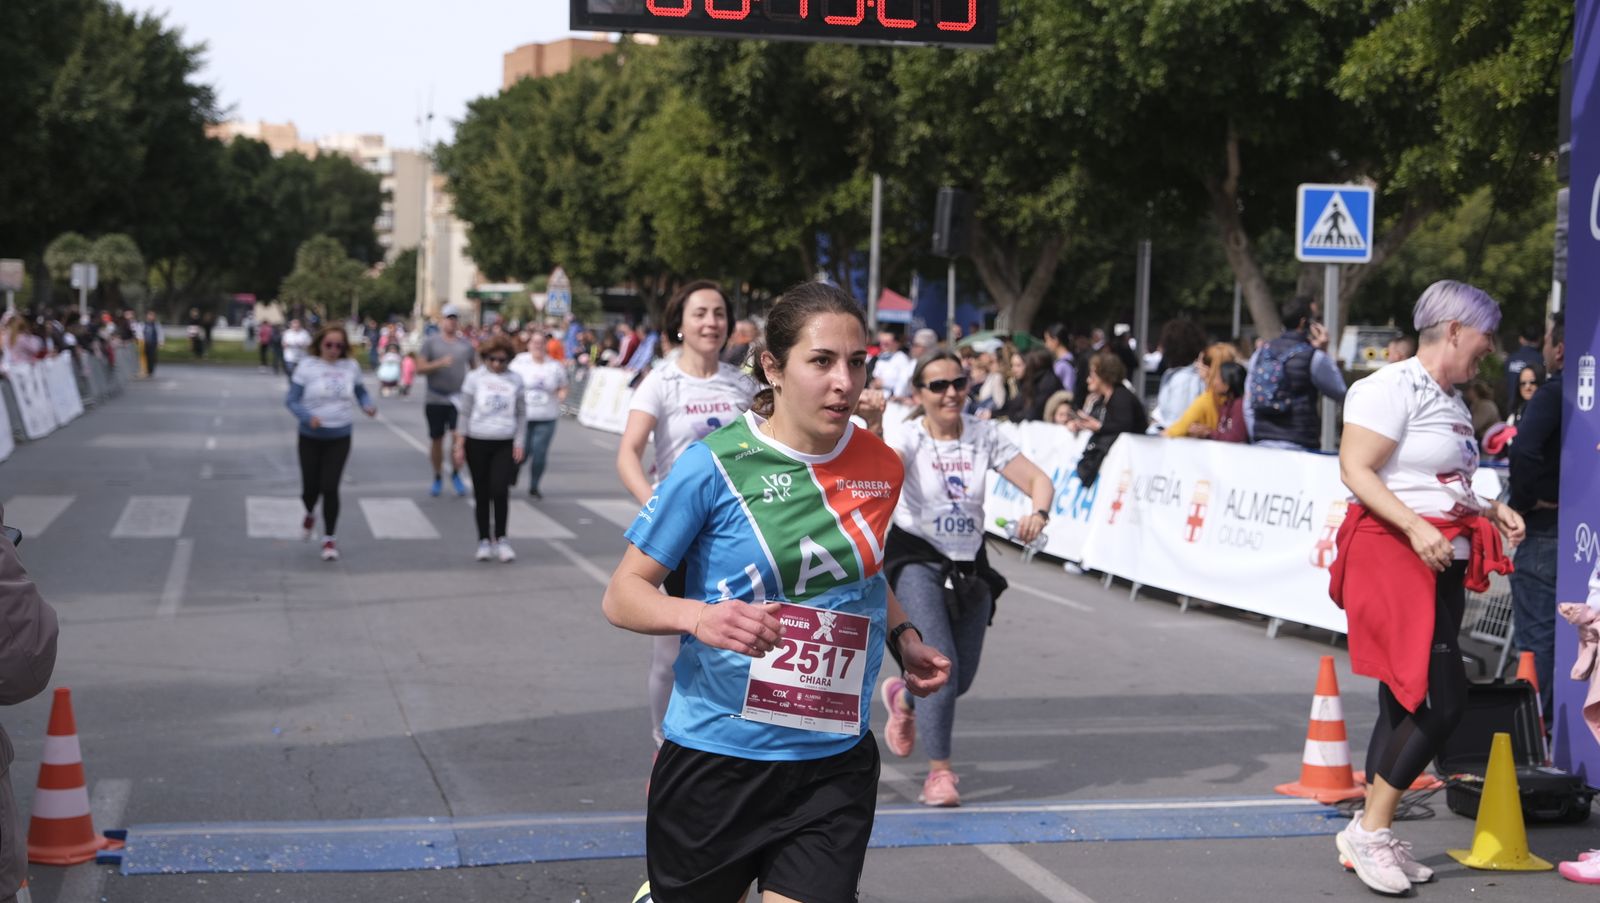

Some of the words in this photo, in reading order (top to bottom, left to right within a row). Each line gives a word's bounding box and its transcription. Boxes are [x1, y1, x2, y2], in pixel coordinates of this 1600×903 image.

[685, 402, 733, 415] MUJER
[769, 473, 792, 487] 10
[845, 480, 891, 490] CARRERA
[762, 488, 774, 503] 5
[783, 487, 791, 497] K
[1224, 488, 1315, 531] ALMERÍA
[933, 516, 975, 533] 1099
[780, 617, 810, 630] MUJER
[771, 639, 855, 680] 2517
[800, 674, 831, 687] CHIARA
